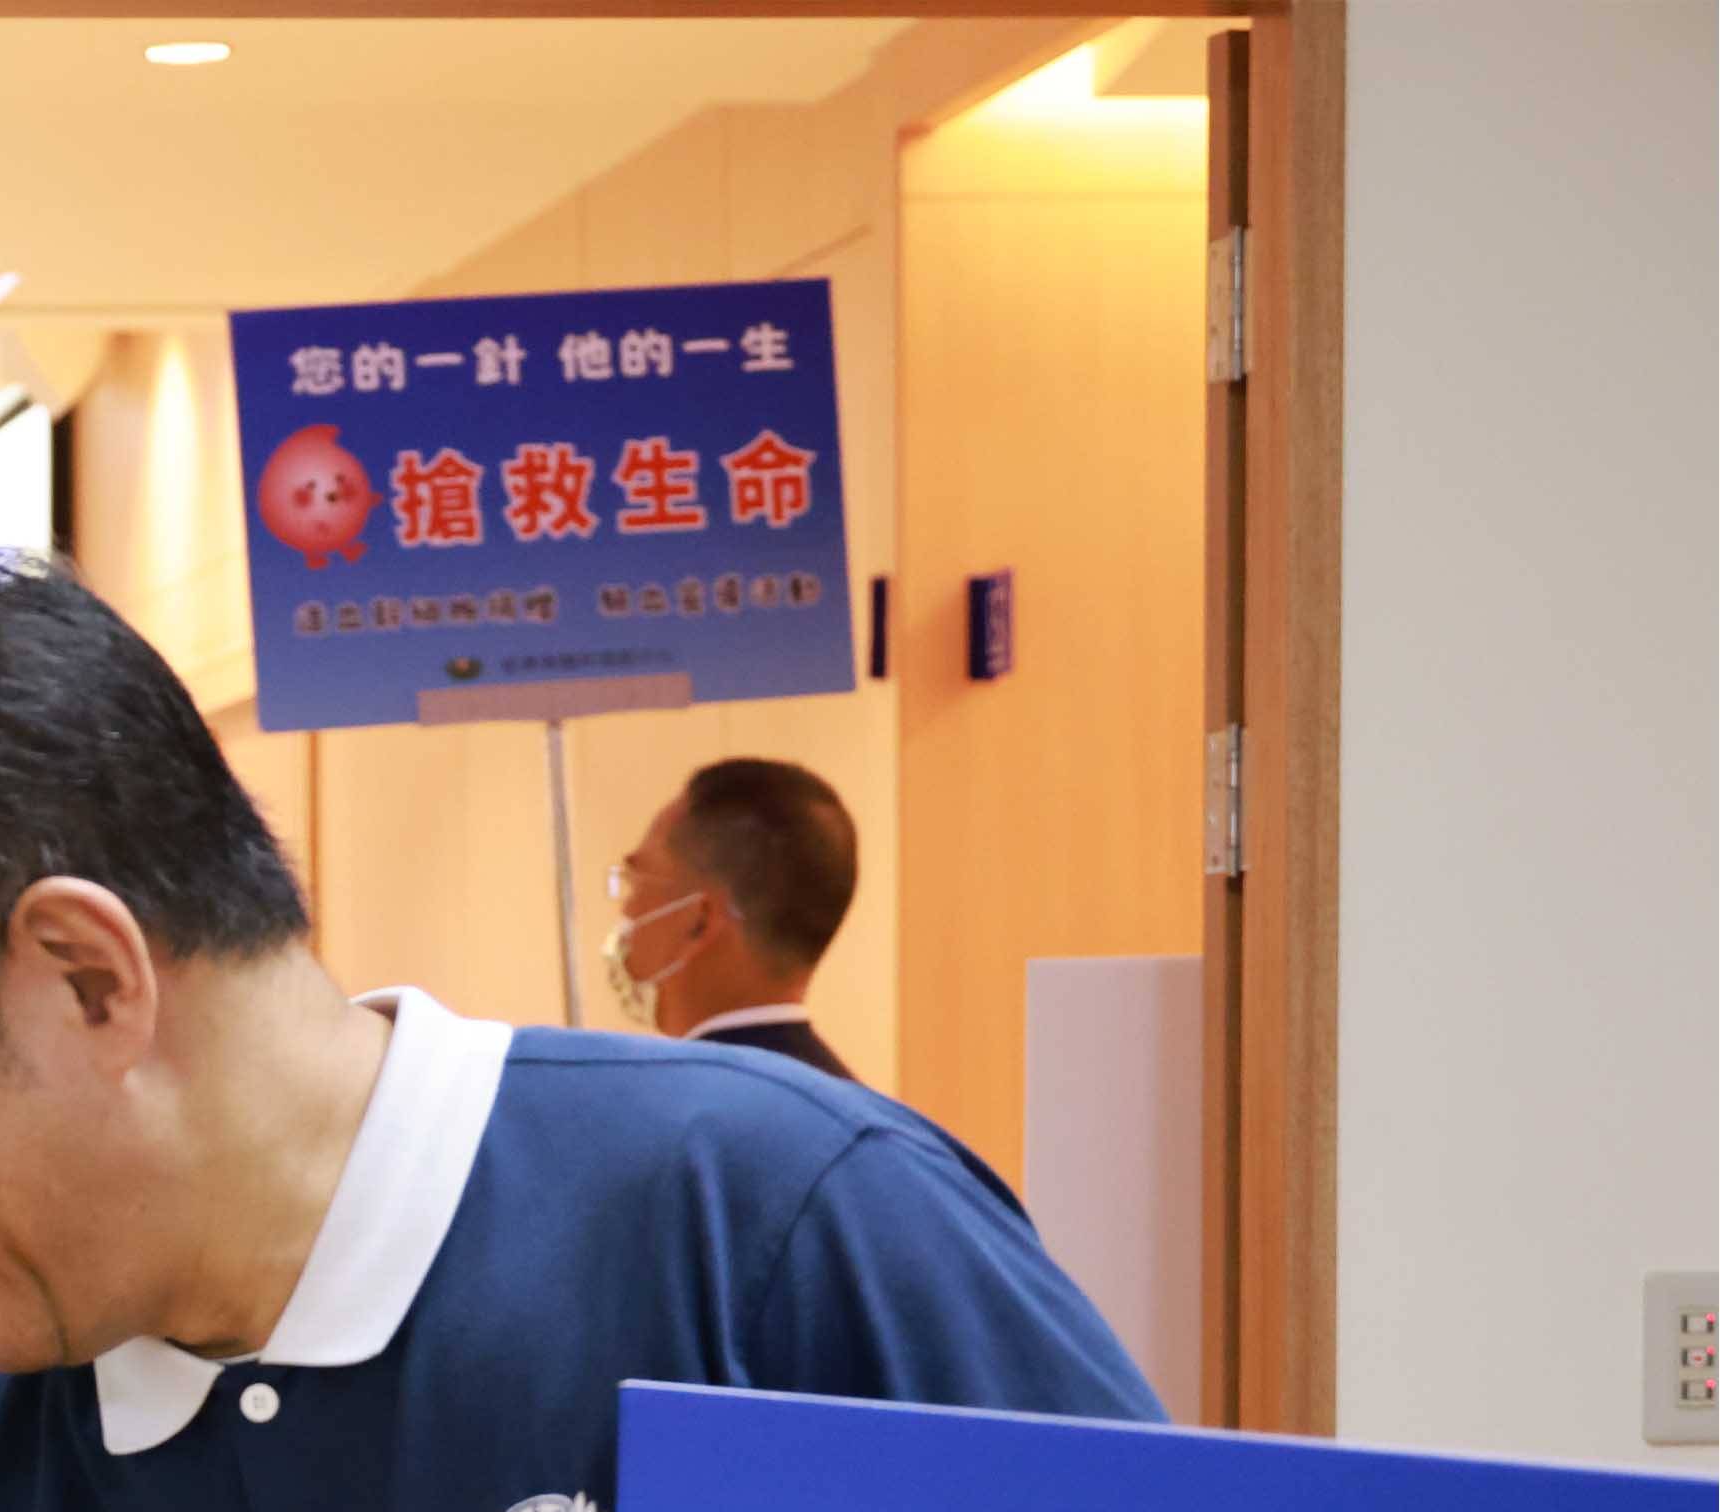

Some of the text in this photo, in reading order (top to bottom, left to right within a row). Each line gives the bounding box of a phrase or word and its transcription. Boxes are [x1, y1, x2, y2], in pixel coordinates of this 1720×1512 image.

[289, 323, 794, 394] 您的一針 他的一生
[390, 428, 817, 549] 搶救生命
